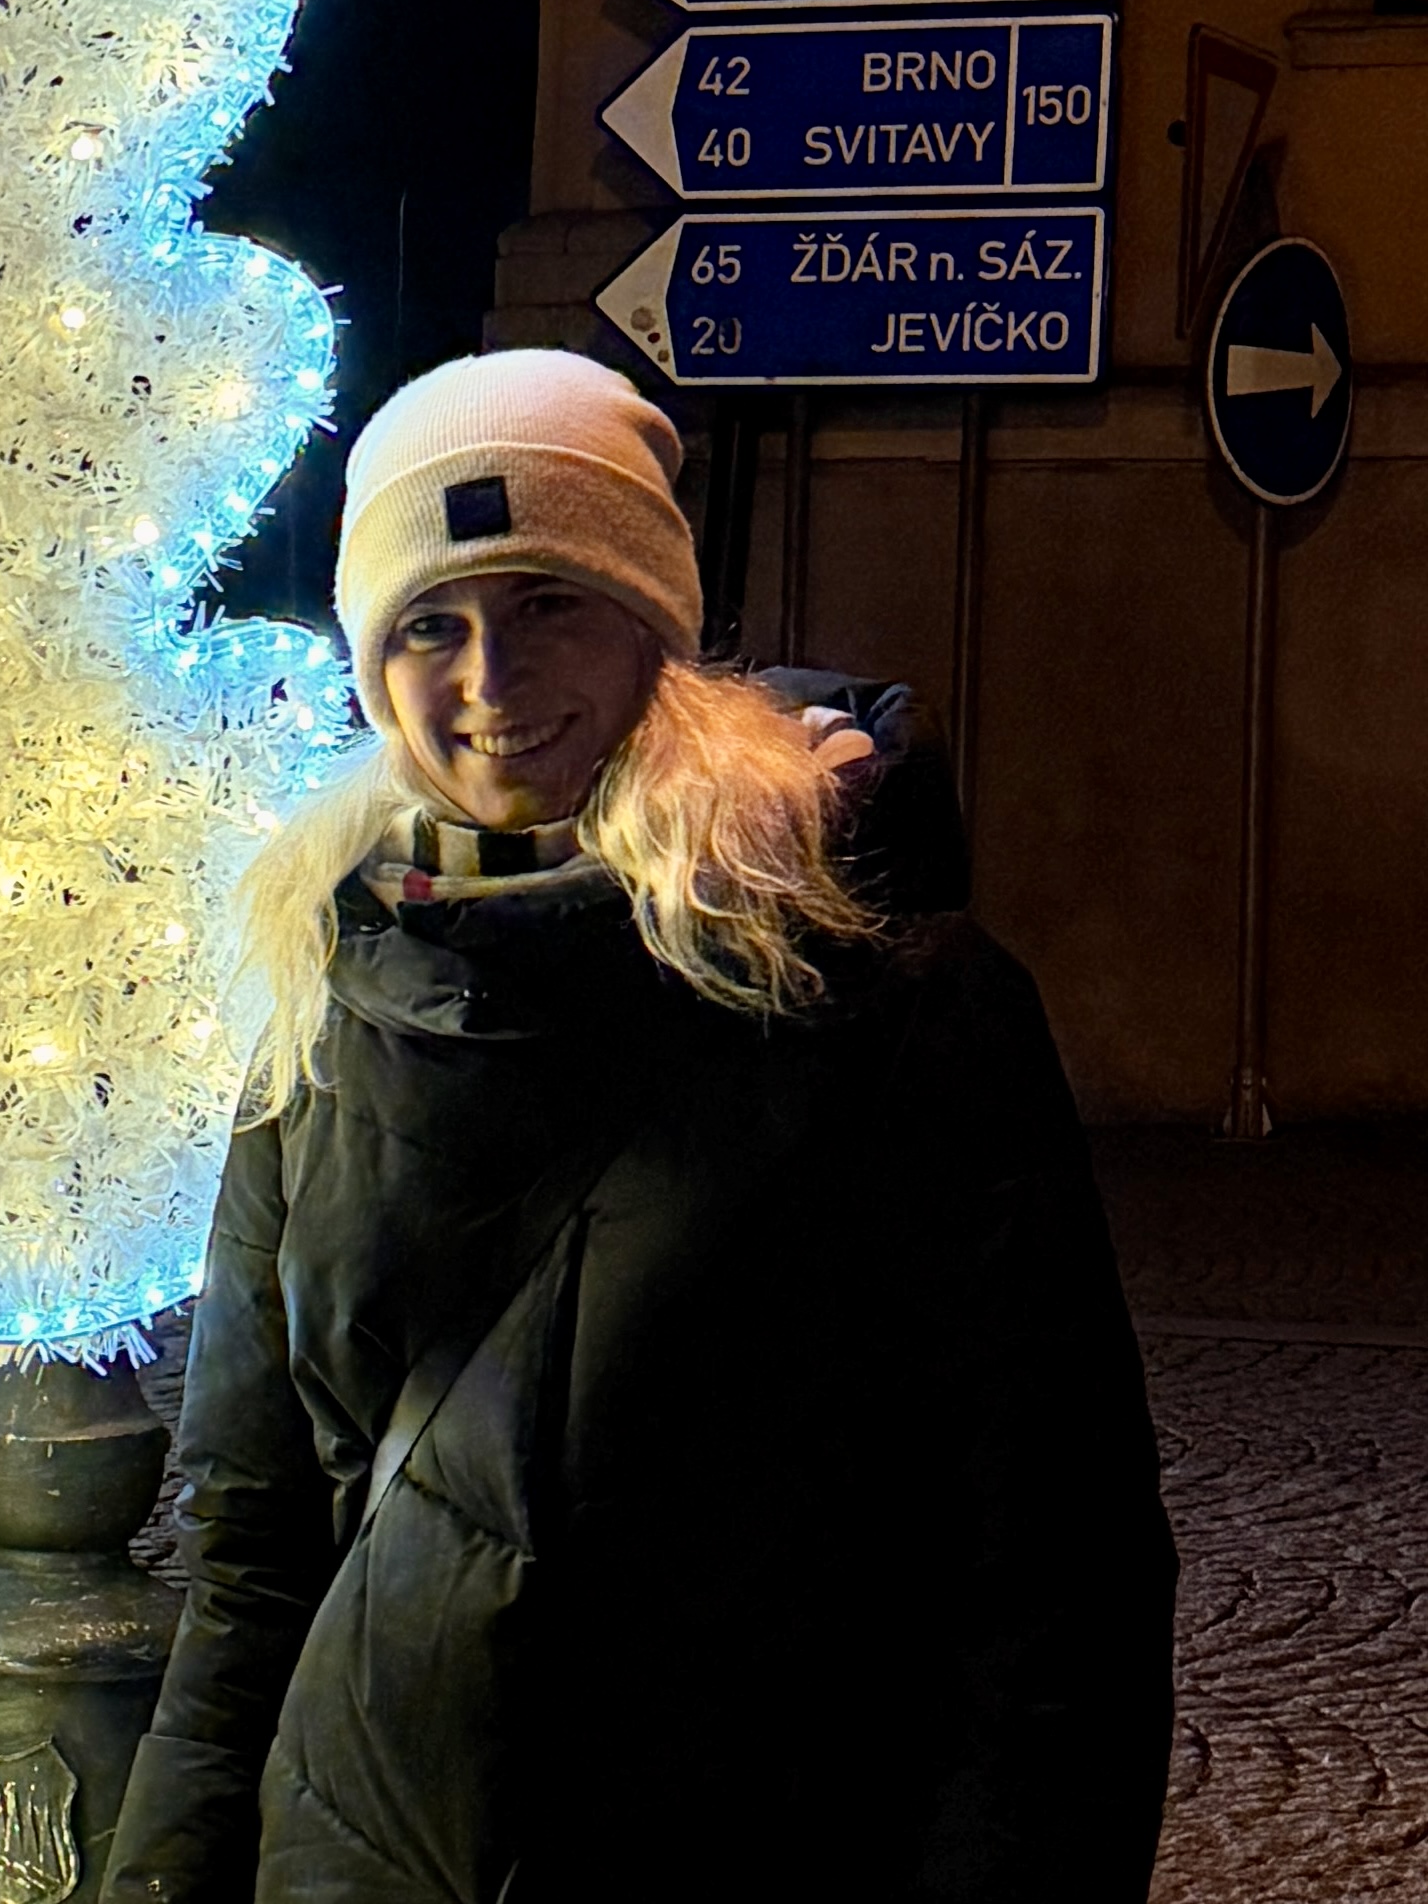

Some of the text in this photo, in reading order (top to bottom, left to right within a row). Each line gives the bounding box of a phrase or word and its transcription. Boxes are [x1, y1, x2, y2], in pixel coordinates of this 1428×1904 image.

[697, 49, 997, 96] 42 BRNO
[1021, 83, 1092, 126] 150
[697, 120, 996, 168] 40 SVITAVY
[690, 229, 1083, 285] 65 ŽĎÁR n. SÁZ.
[690, 301, 1070, 356] 20 JEVÍČKO
